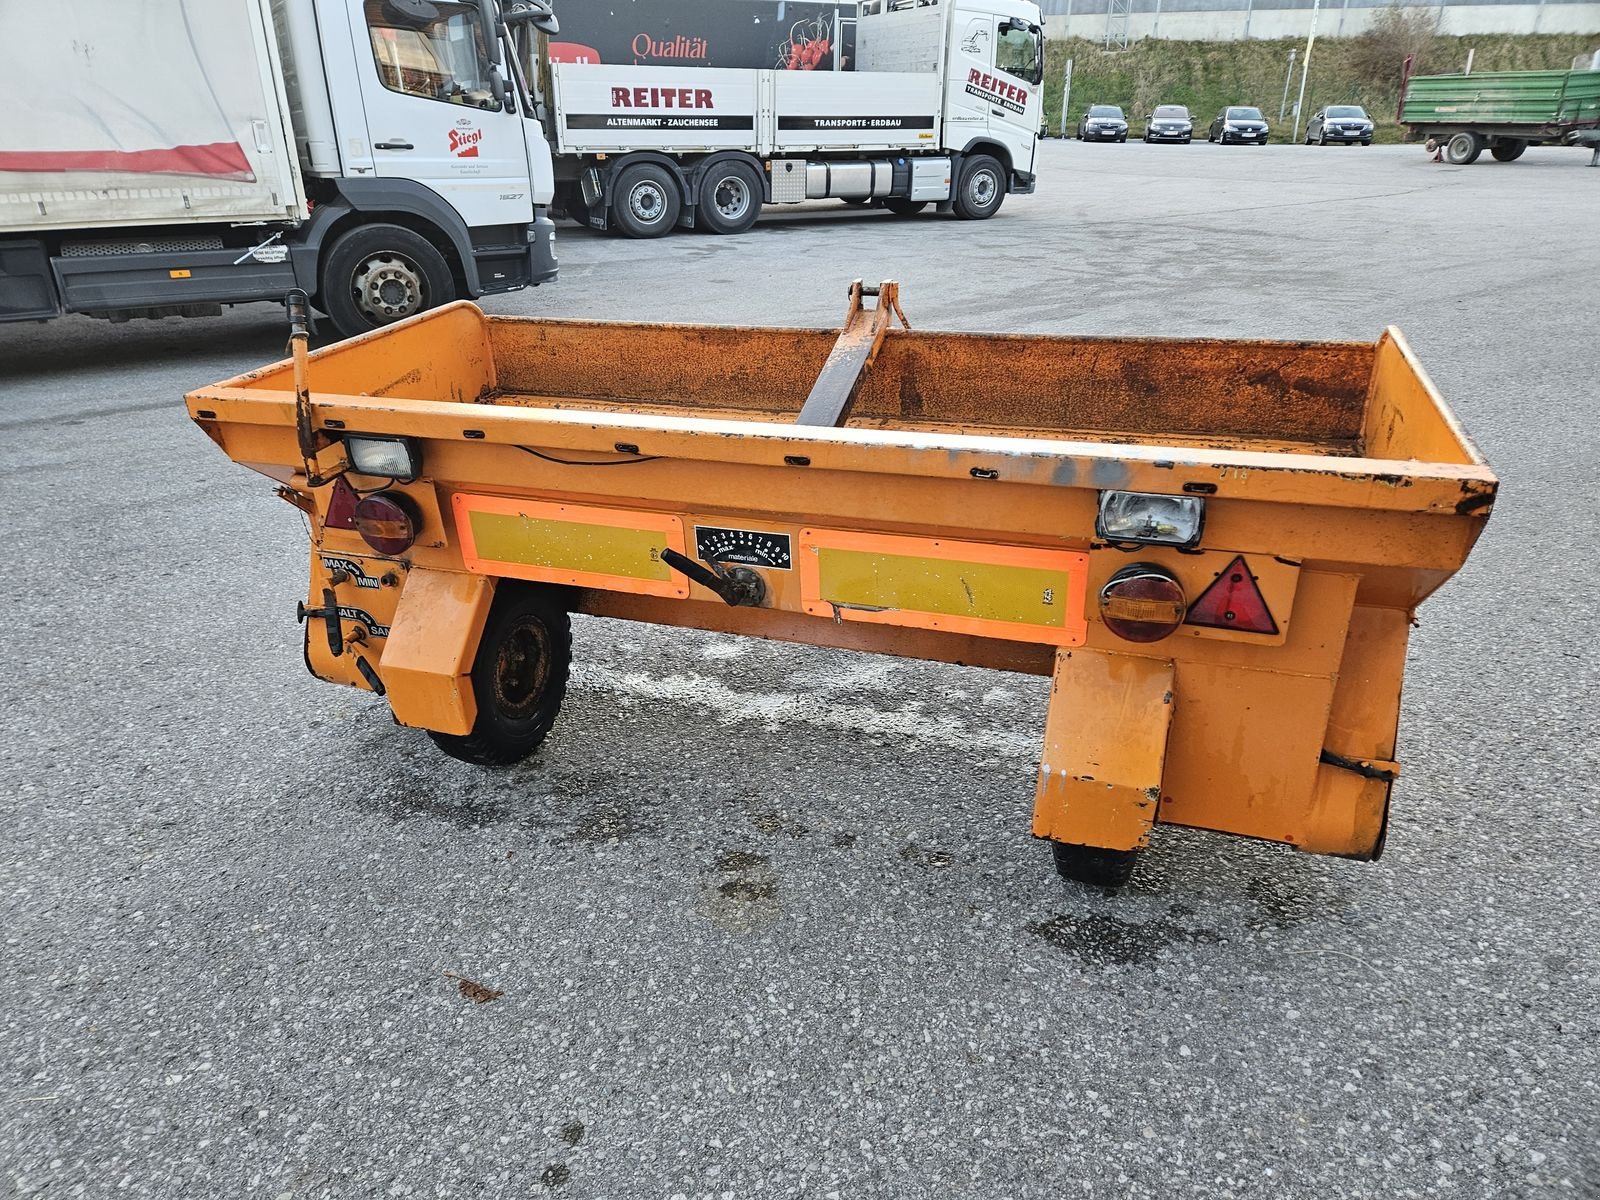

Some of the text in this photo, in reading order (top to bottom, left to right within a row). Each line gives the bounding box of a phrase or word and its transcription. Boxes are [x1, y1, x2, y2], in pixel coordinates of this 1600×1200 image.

[632, 33, 708, 60] Qualität
[968, 68, 1028, 106] REITER
[611, 87, 714, 109] REITER
[966, 85, 1024, 114] TRANSPORTE ERDBAU
[606, 118, 662, 126] ALTENMARKT
[667, 118, 719, 127] ZAUCHENSEE
[871, 119, 902, 127] ERDBAU
[448, 128, 483, 152] Stiegl
[718, 545, 768, 559] max min
[782, 553, 789, 561] 10
[728, 554, 758, 562] materiale
[324, 558, 349, 570] MAX
[357, 577, 379, 588] MIN
[338, 608, 358, 618] ALT
[370, 626, 391, 636] SAN
